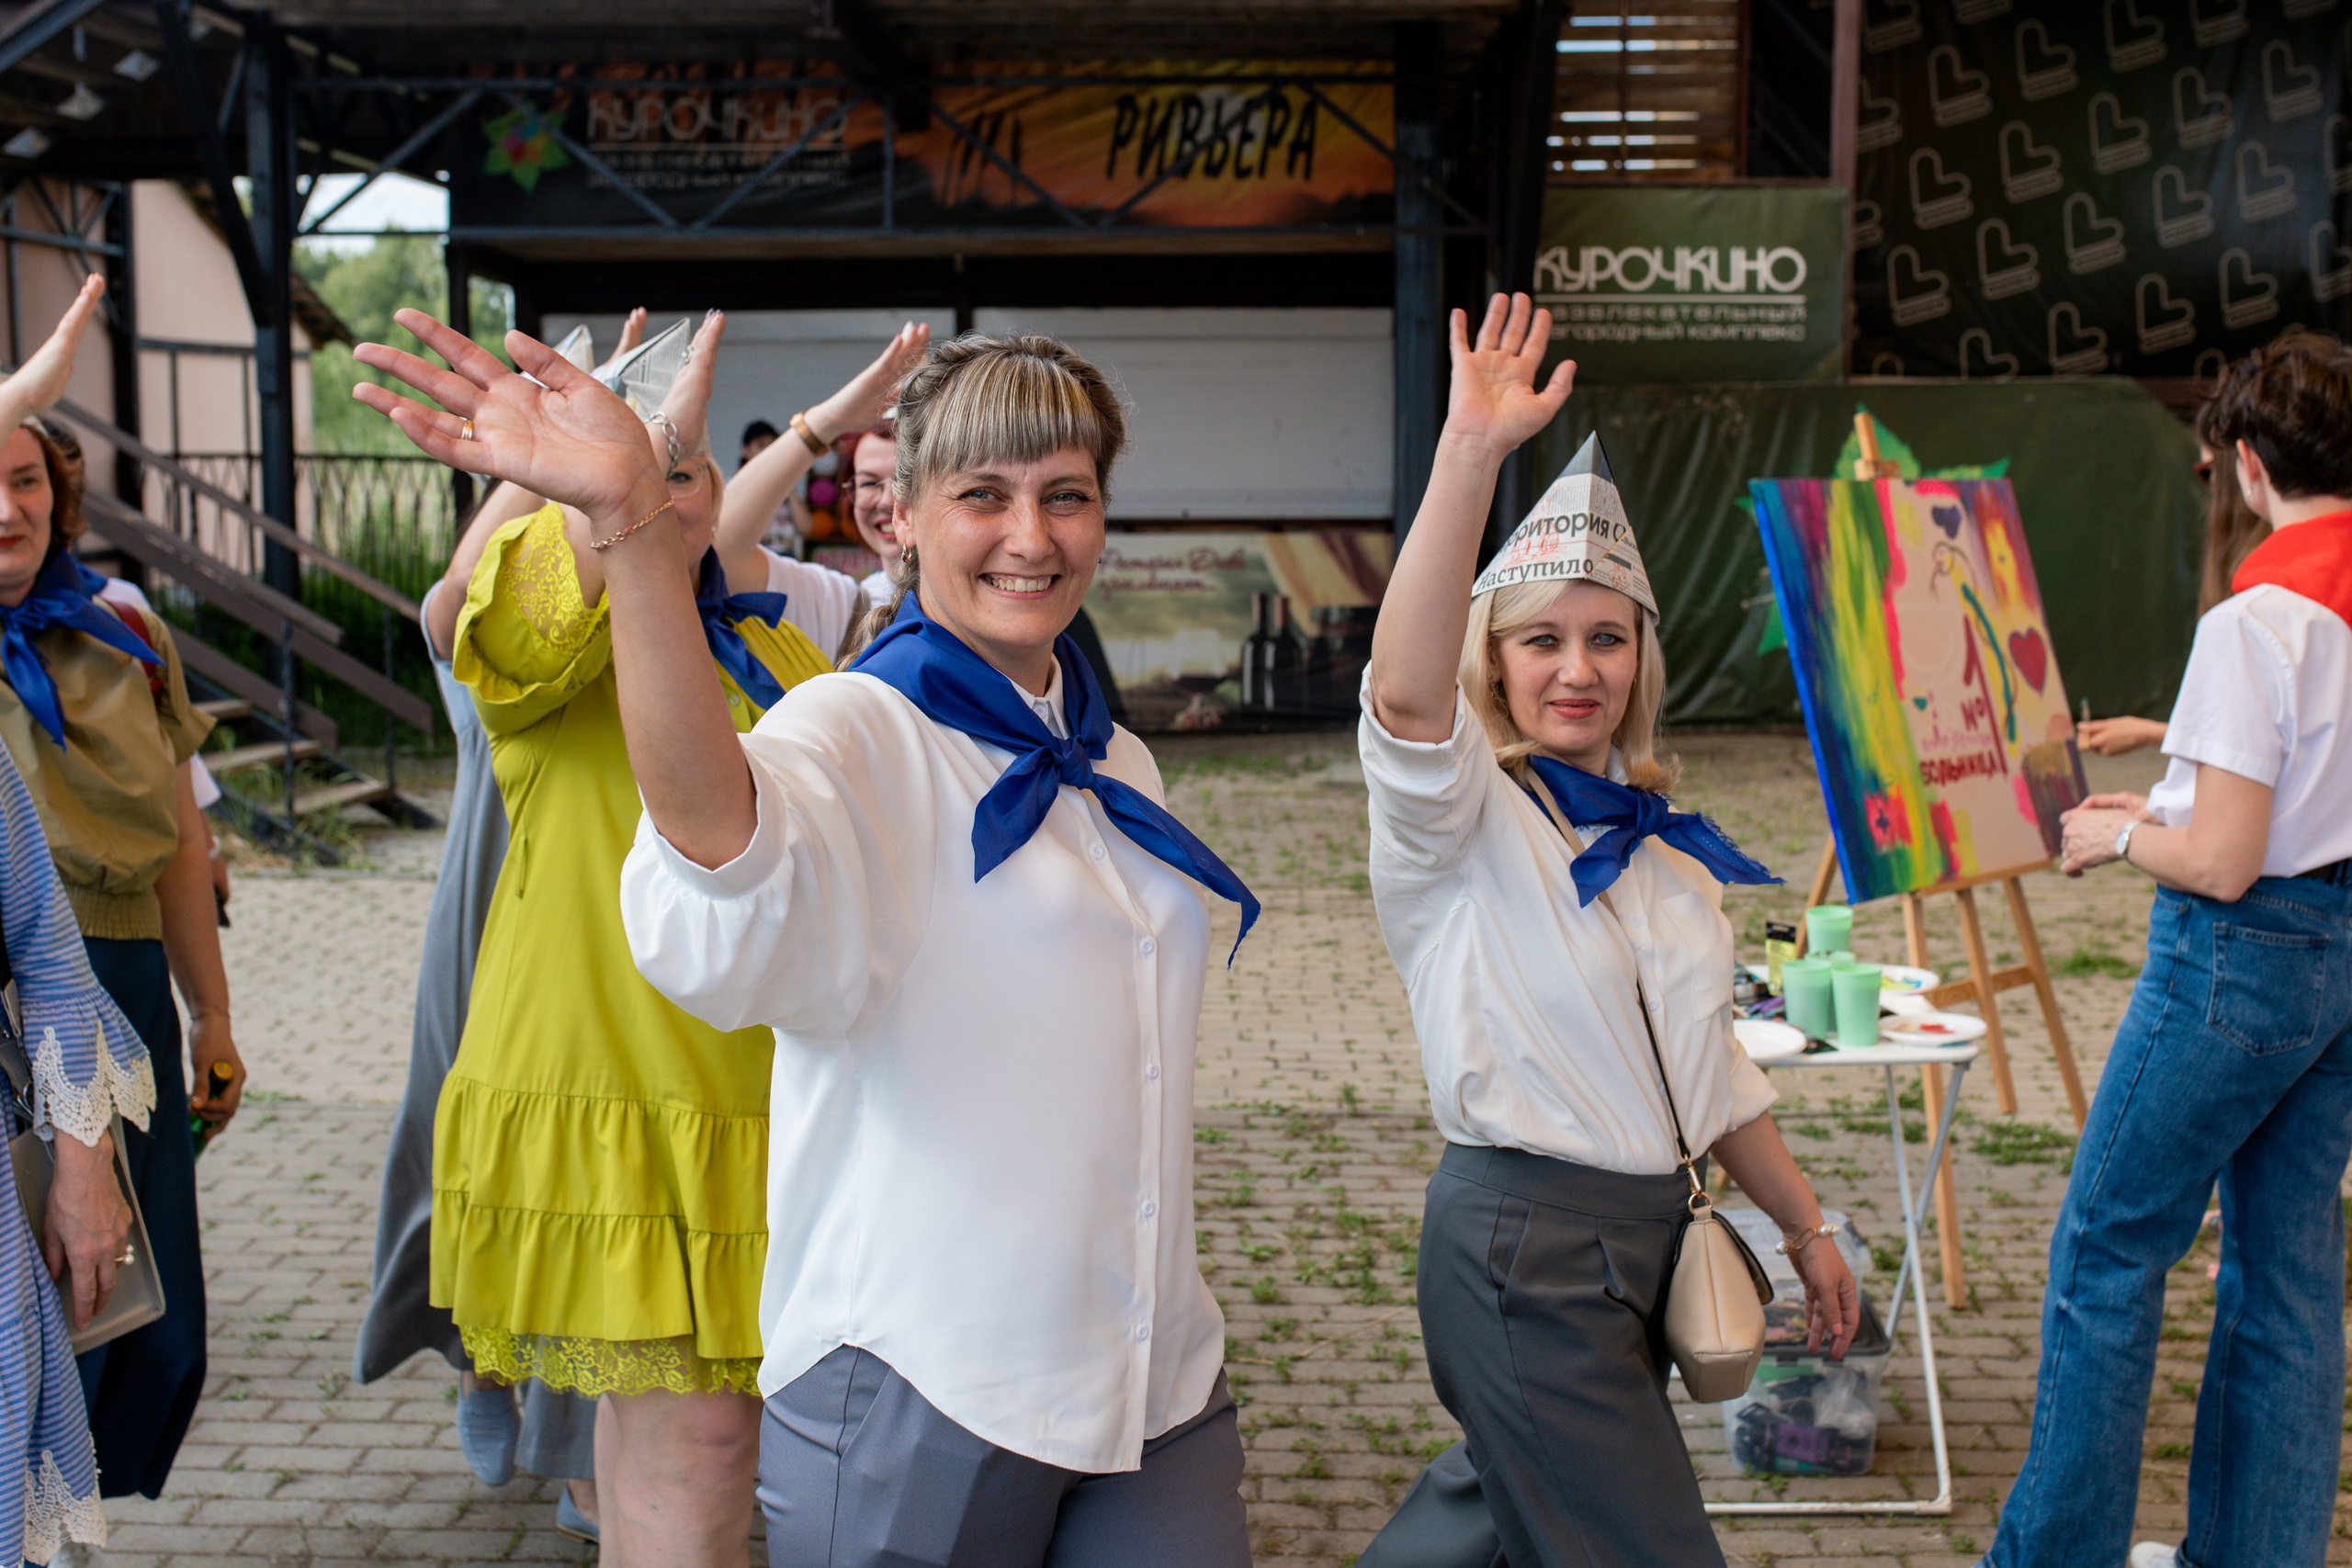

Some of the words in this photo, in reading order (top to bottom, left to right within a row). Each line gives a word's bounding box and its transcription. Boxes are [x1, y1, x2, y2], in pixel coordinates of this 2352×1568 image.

[586, 96, 849, 141] КУРОЧКИНО
[1106, 94, 1318, 181] РИВЬЕРА
[1533, 245, 1807, 293] КУРОЧКИНО
[1551, 322, 1685, 343] агородный
[1552, 304, 1807, 322] азвлекательный
[1476, 558, 1594, 592] Наступило
